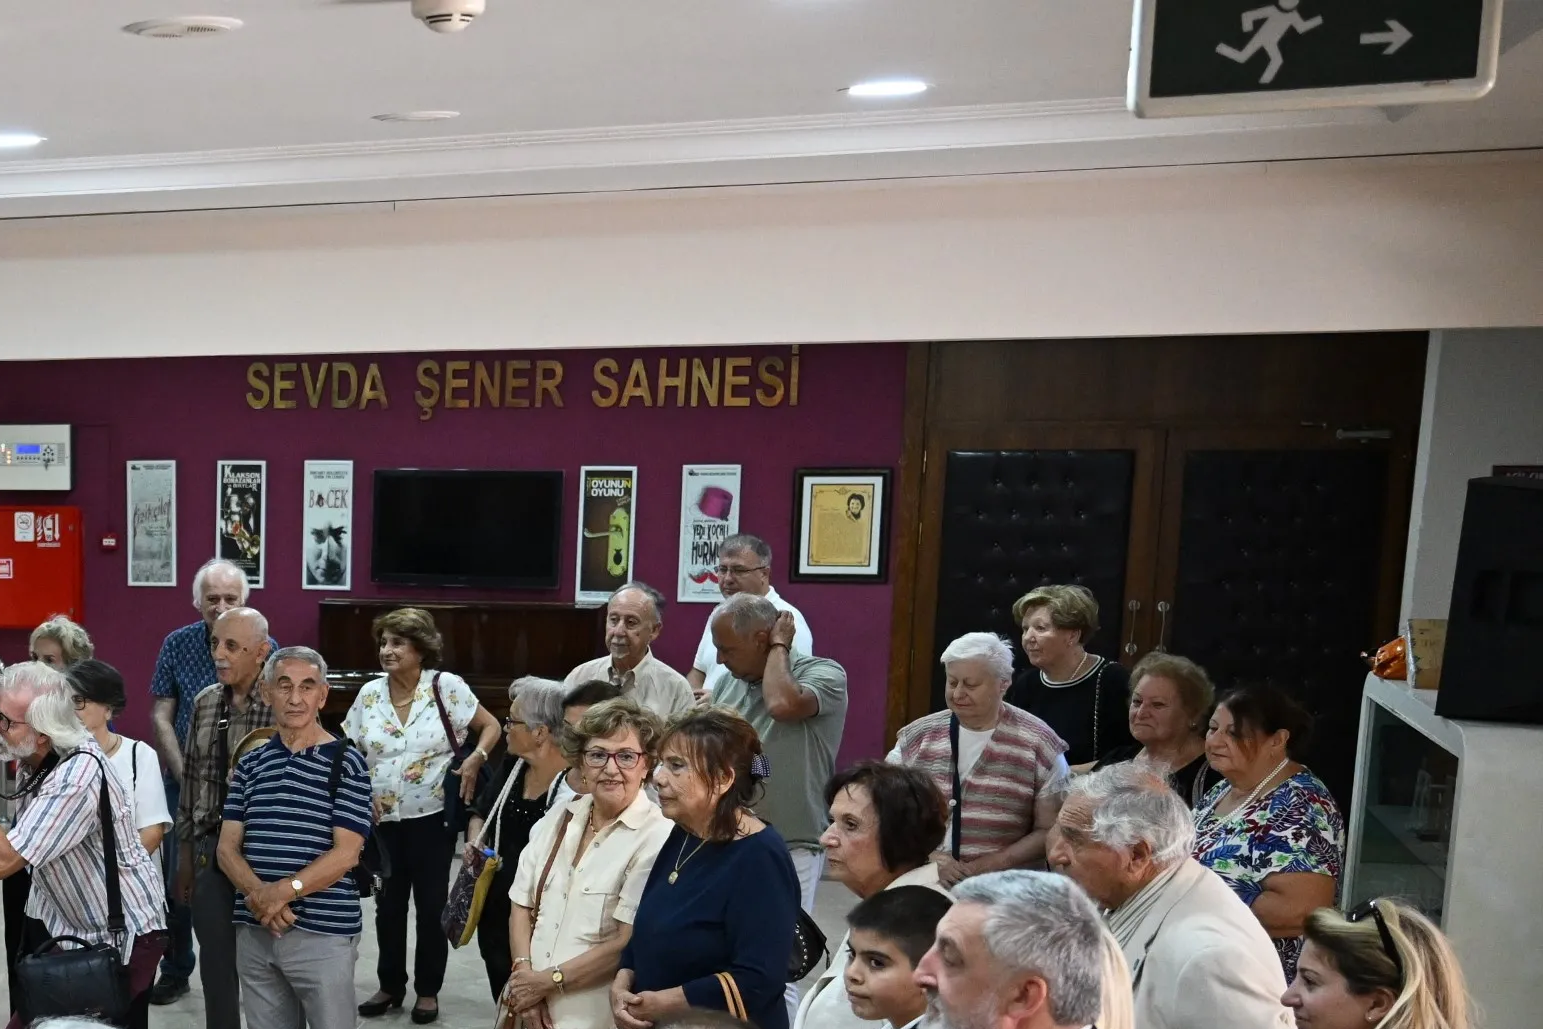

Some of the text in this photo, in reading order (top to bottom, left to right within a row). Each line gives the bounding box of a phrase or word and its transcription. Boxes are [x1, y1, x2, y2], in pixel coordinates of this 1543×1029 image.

[246, 344, 801, 421] SEVDA ŞENER SAHNESİ
[591, 479, 632, 489] OYUNUN
[591, 488, 625, 497] OYUNU
[27, 768, 47, 790] DIGITAL
